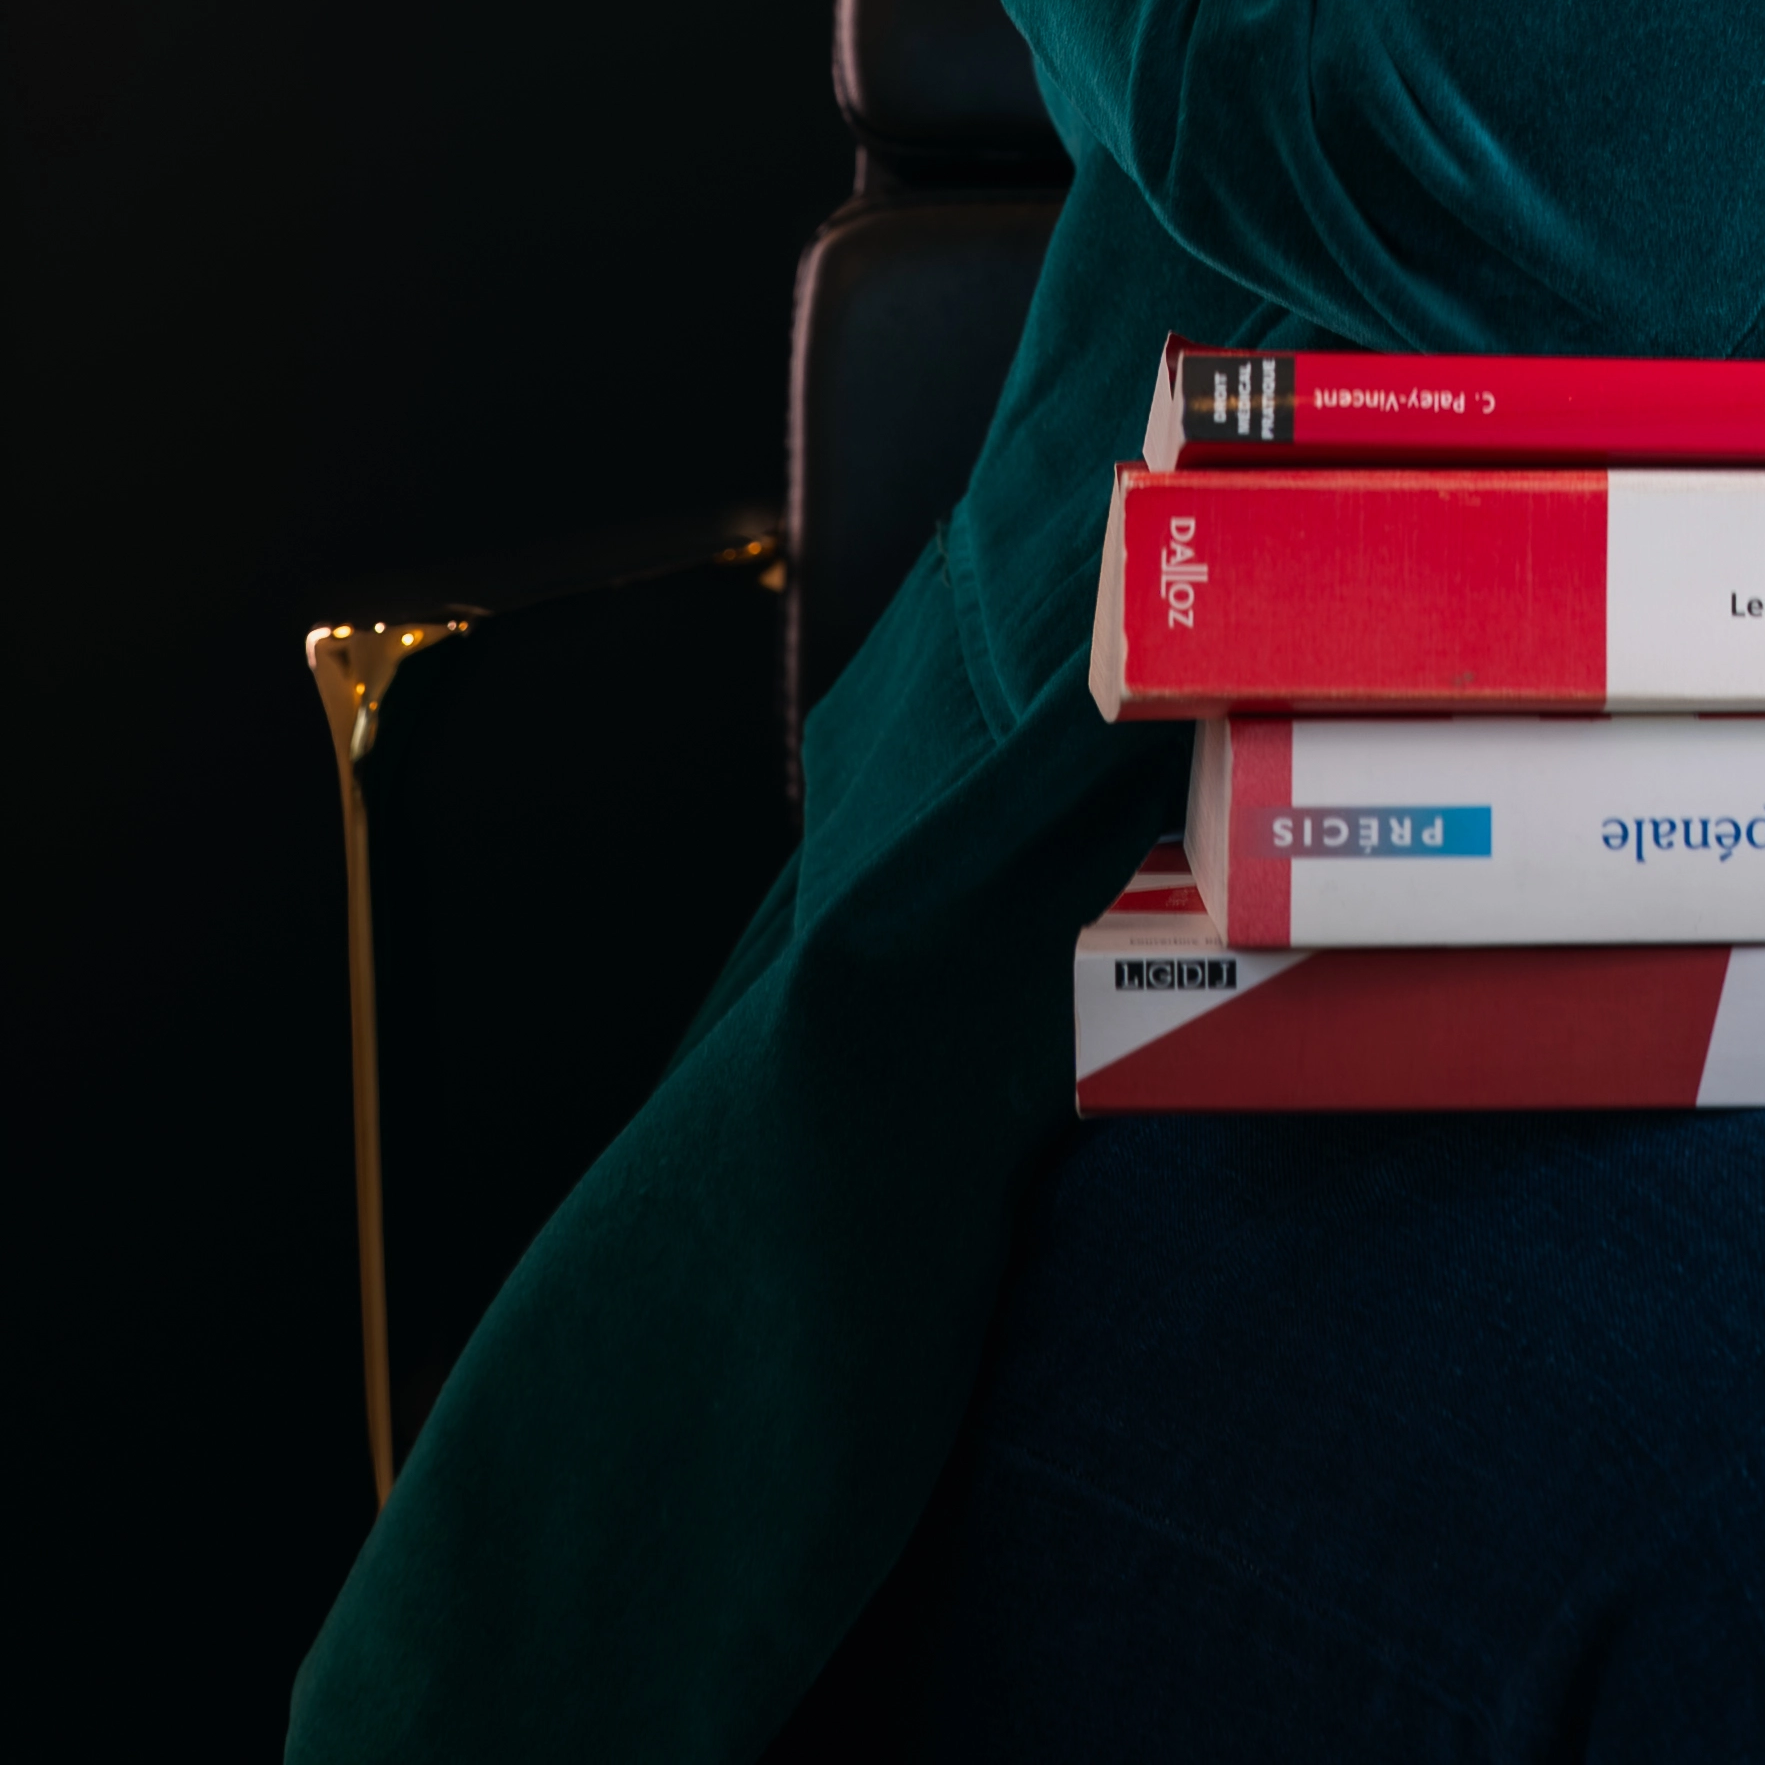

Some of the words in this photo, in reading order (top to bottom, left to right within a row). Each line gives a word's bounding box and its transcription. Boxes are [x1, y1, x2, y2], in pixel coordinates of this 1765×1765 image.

[1212, 371, 1228, 423] DROIT
[1260, 358, 1277, 440] PRATIQUE
[1313, 387, 1466, 415] Paley-Vincent
[1475, 391, 1496, 415] C.
[1160, 516, 1209, 629] DALLOZ
[1272, 815, 1444, 855] PRÉCIS
[1119, 960, 1232, 990] LGDJ
